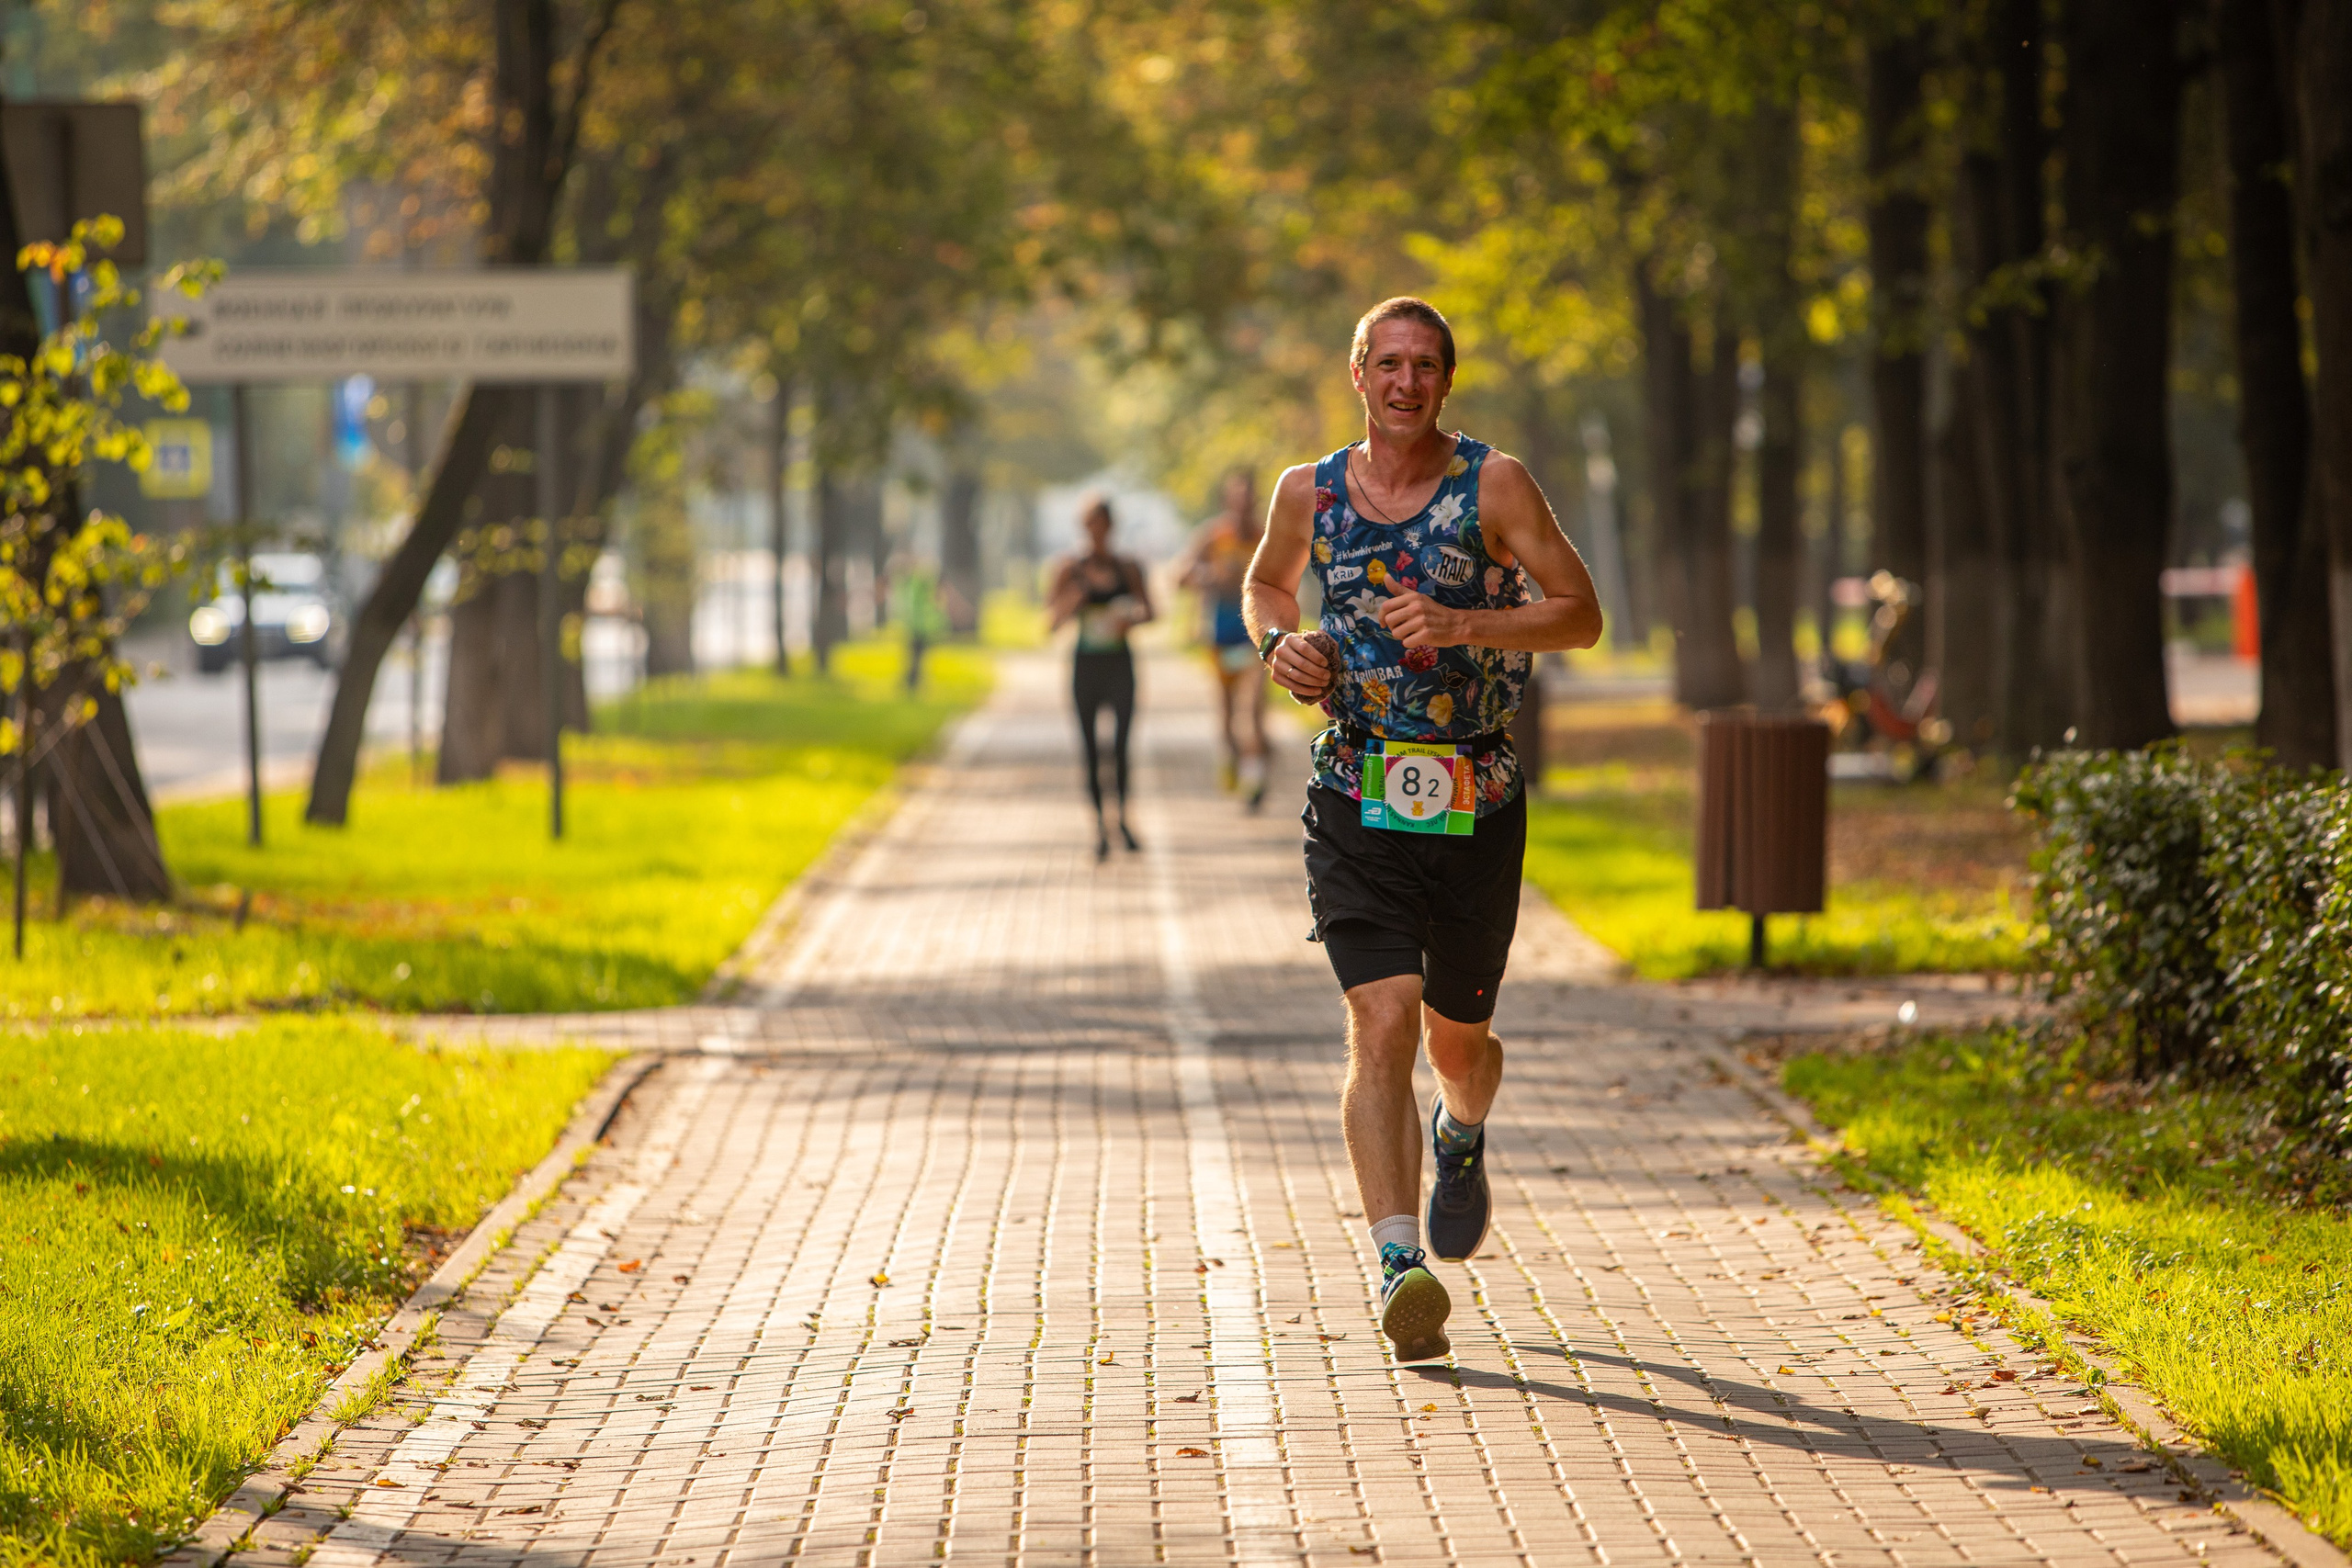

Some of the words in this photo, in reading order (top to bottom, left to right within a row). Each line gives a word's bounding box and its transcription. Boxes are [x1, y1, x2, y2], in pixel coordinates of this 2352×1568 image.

[1336, 541, 1393, 562] #khimkirunbar
[1333, 570, 1354, 581] KRB
[1386, 750, 1407, 766] DREAM
[1427, 750, 1452, 768] LYSKOVO
[1402, 766, 1420, 796] 8
[1428, 778, 1440, 797] 2
[1463, 764, 1471, 805] ЭСТАФЕТА
